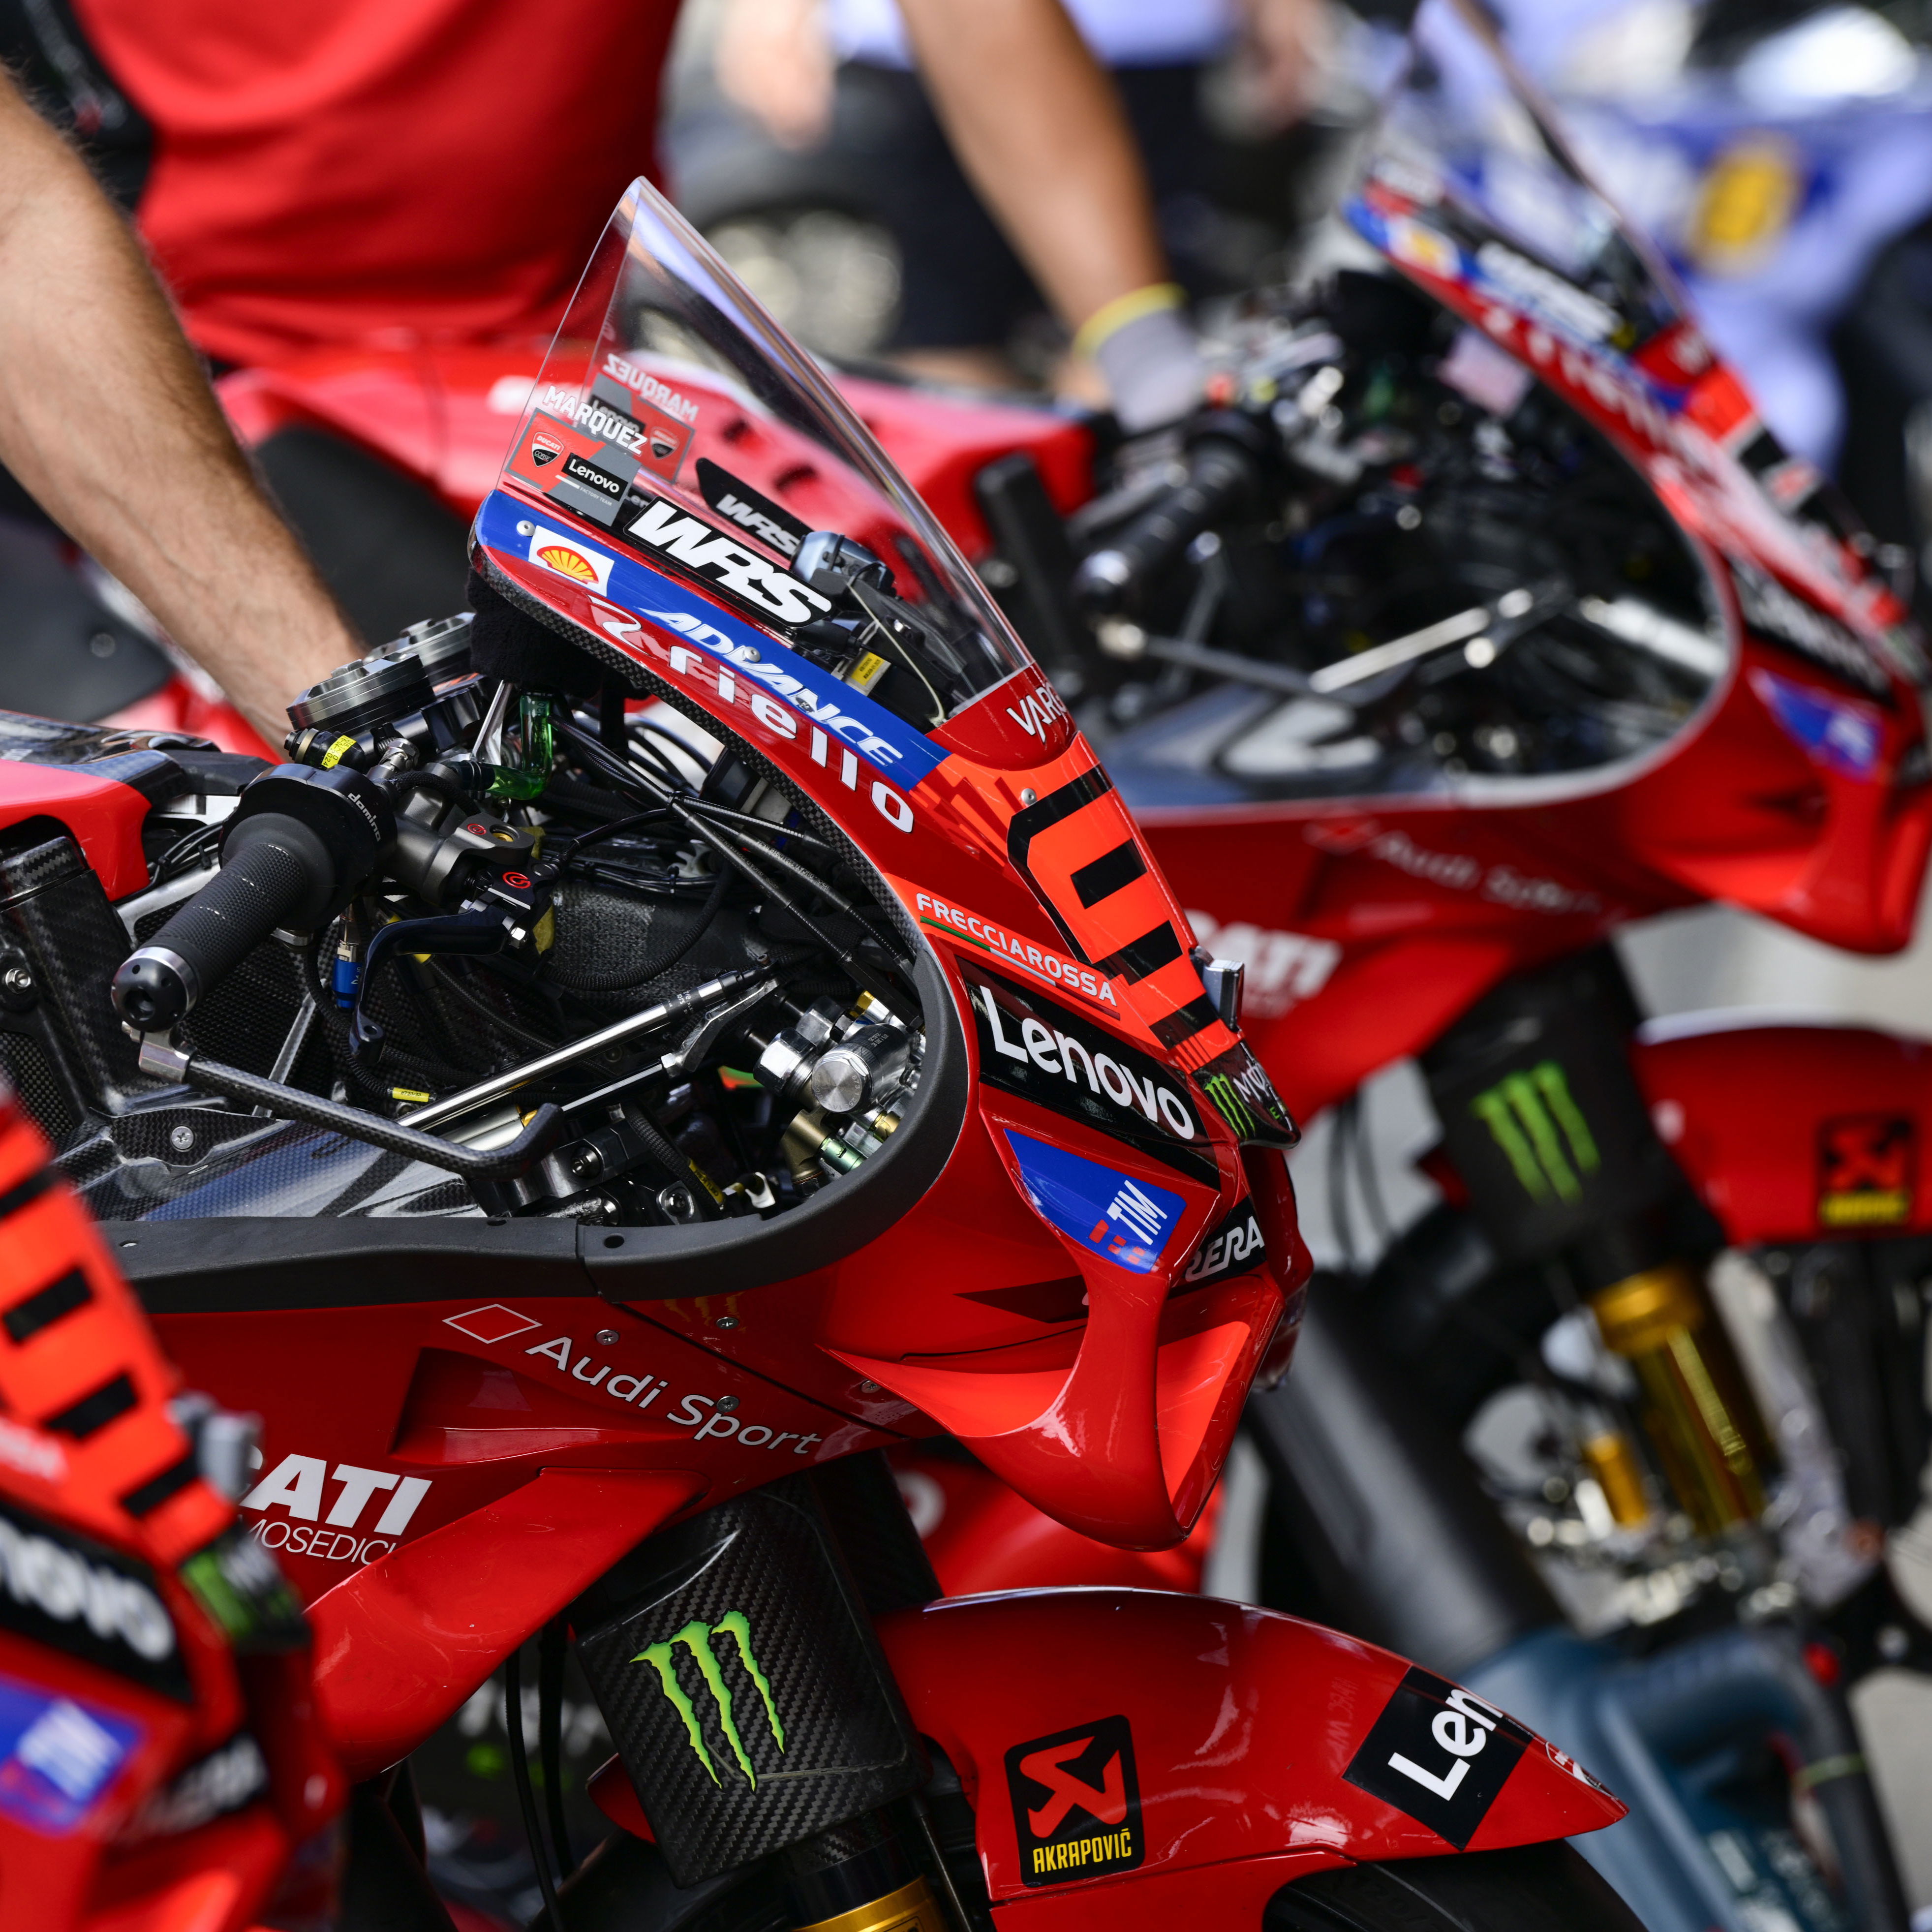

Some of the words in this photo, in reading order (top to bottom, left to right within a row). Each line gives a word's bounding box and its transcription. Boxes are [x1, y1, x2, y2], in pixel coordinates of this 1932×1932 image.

[537, 435, 561, 450] DUCATI
[543, 386, 647, 455] MARQUEZ
[534, 450, 551, 461] CORSE
[568, 459, 620, 493] Lenovo
[580, 487, 599, 500] FACTORY
[599, 496, 613, 506] TEAM
[627, 500, 832, 623] WRS
[347, 793, 381, 842] domino
[916, 893, 1117, 1007] FRECCIAROSSA
[980, 985, 1195, 1139] Lenovo
[1106, 1180, 1167, 1245] TIM
[524, 1336, 668, 1409] Audi
[667, 1395, 823, 1455] Sport
[1033, 1828, 1132, 1873] AKRAPOVIČ
